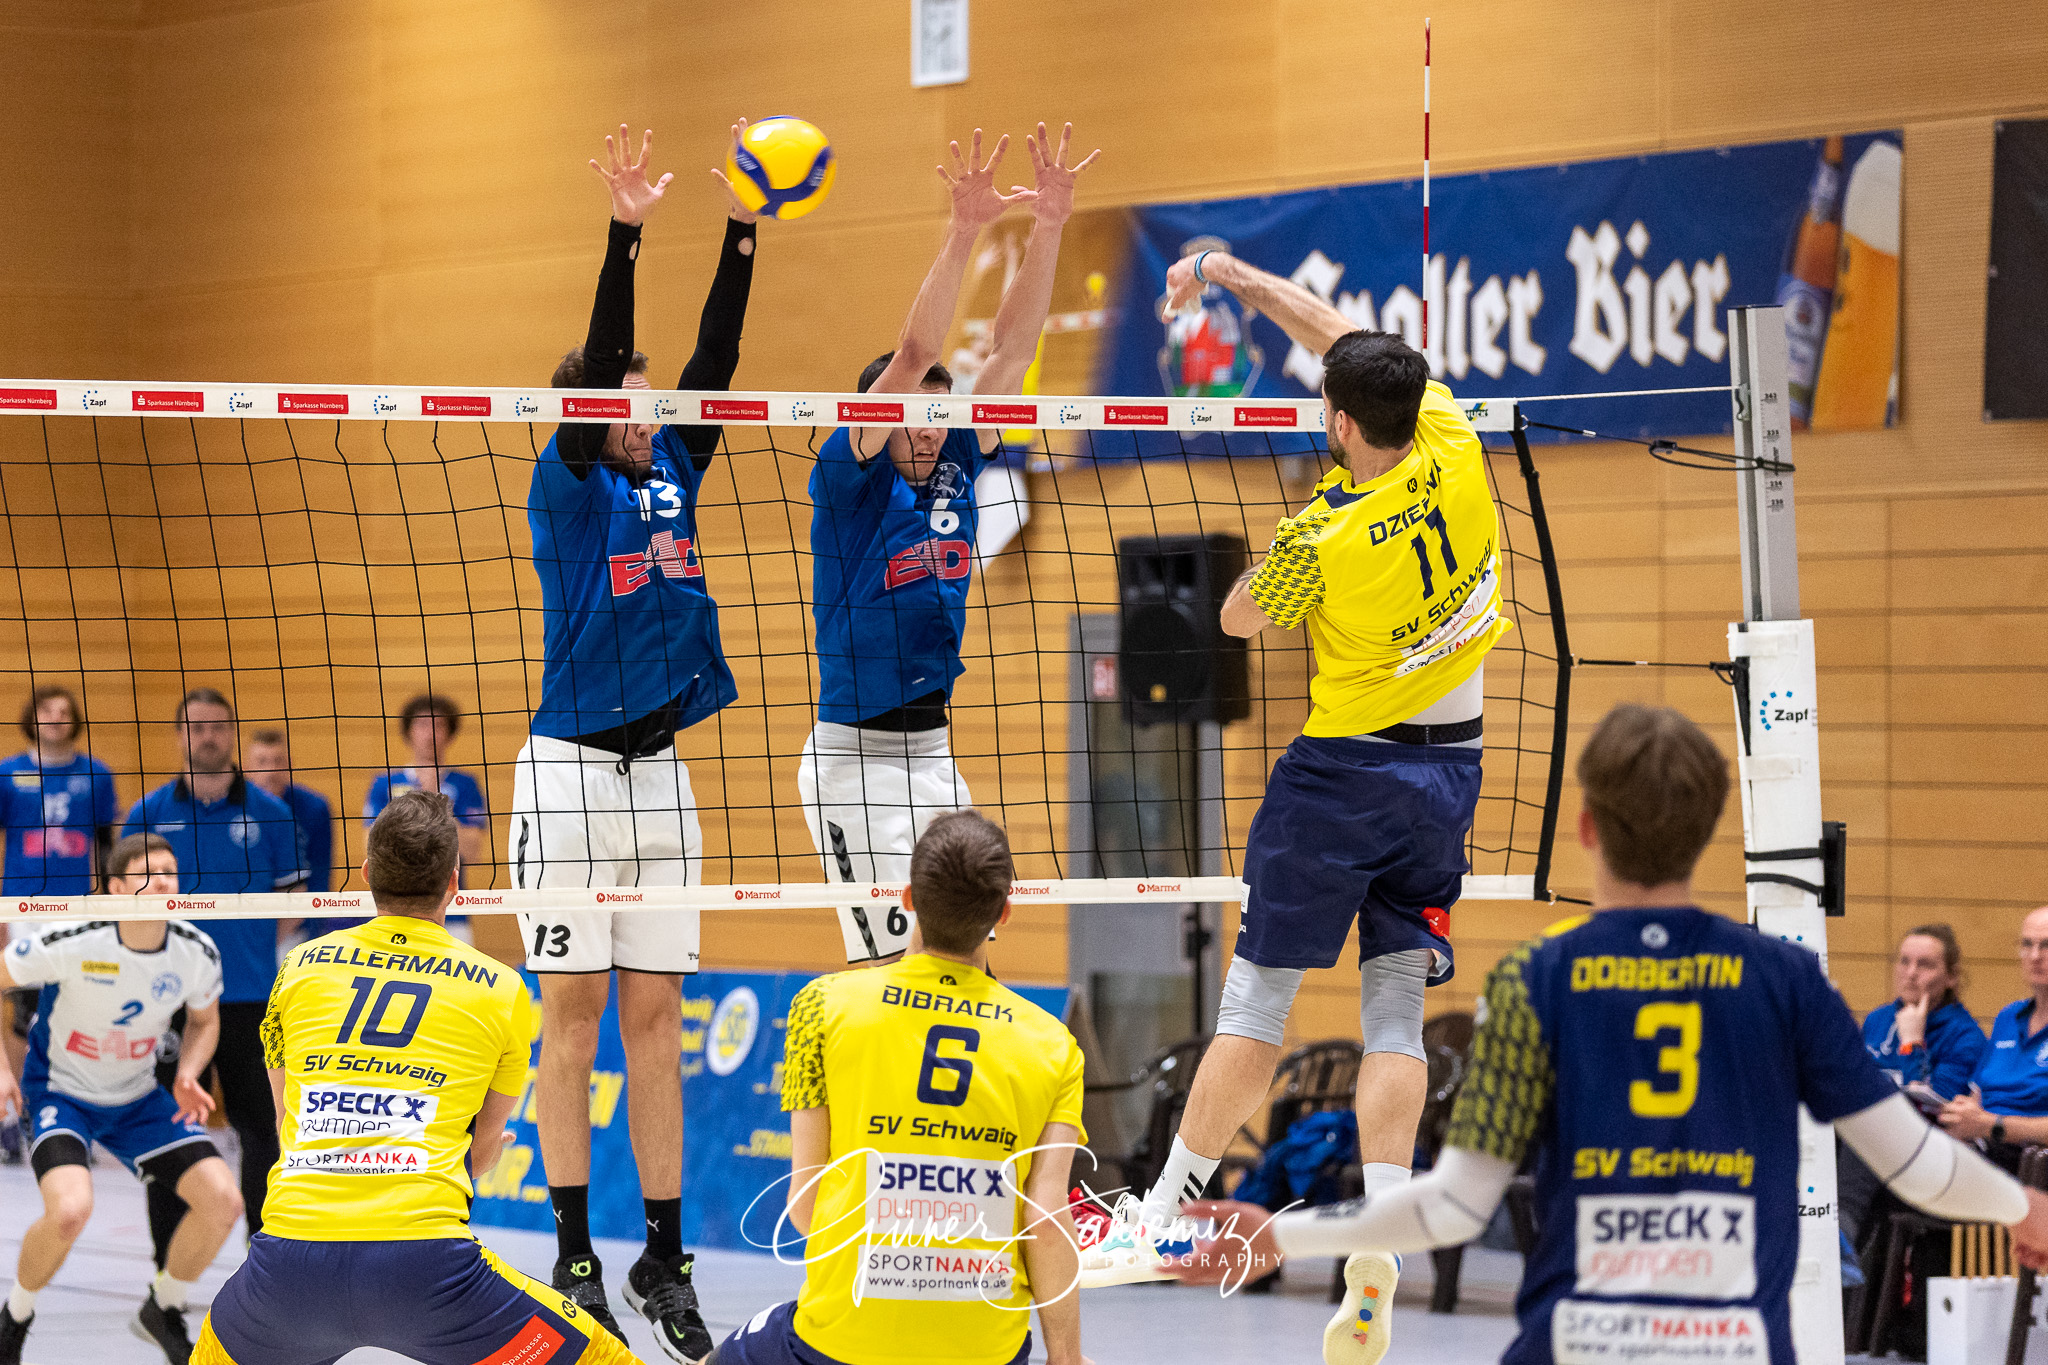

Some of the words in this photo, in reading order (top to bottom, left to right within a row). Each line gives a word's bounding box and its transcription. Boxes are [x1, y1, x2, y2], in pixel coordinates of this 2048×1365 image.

[1565, 219, 1730, 374] Bier
[148, 399, 173, 407] Sparkasse
[174, 400, 199, 408] Nürnberg
[293, 402, 319, 410] Sparkasse
[320, 402, 344, 410] Nürnberg
[436, 404, 462, 412] Sparkasse
[463, 404, 487, 412] Nürnberg
[577, 406, 602, 414] Sparkasse
[603, 406, 627, 414] Nürnberg
[715, 408, 740, 416] Sparkasse
[741, 409, 764, 417] Nürnberg
[852, 410, 876, 418] Sparkasse
[877, 411, 900, 419] Nürnberg
[1010, 412, 1033, 420] Nürnberg
[1271, 415, 1293, 423] Nürnberg
[633, 480, 682, 522] 13
[930, 498, 960, 535] 6
[609, 530, 703, 596] EAD
[884, 537, 970, 590] EAD
[1410, 504, 1459, 601] 11
[1392, 616, 1420, 642] SV
[1427, 538, 1491, 624] Schwaig
[1775, 708, 1808, 723] Zapf
[466, 895, 503, 905] Marmot
[606, 893, 643, 902] Marmot
[744, 890, 781, 899] Marmot
[881, 889, 902, 897] Mar
[1015, 886, 1050, 895] Marmot
[1147, 884, 1181, 892] Marmot
[30, 902, 69, 911] Marmot
[177, 900, 216, 909] Marmot
[322, 898, 361, 907] Marmot
[887, 906, 908, 936] 6
[533, 924, 571, 957] 13
[298, 945, 498, 988] KELLERMANN
[1571, 954, 1743, 992] DOBBERTIN
[113, 1000, 144, 1026] 2
[335, 976, 432, 1048] 10
[882, 985, 1013, 1022] BIBRACK
[66, 1030, 157, 1060] EAD
[303, 1055, 332, 1072] SV
[336, 1054, 447, 1087] Schwaig
[916, 1024, 980, 1107] 6
[1629, 1001, 1702, 1118] 3
[306, 1091, 397, 1116] SPECK
[867, 1116, 903, 1135] SV
[910, 1117, 1018, 1151] Schwaig
[879, 1162, 976, 1195] SPECK
[1572, 1148, 1620, 1179] SV
[1629, 1147, 1755, 1187] Schwaig
[877, 1197, 976, 1224] pumpen
[1798, 1203, 1830, 1217] Zapf
[1593, 1205, 1711, 1244] SPECK
[502, 1333, 543, 1365] Sparkasse
[518, 1341, 550, 1365] rnberg
